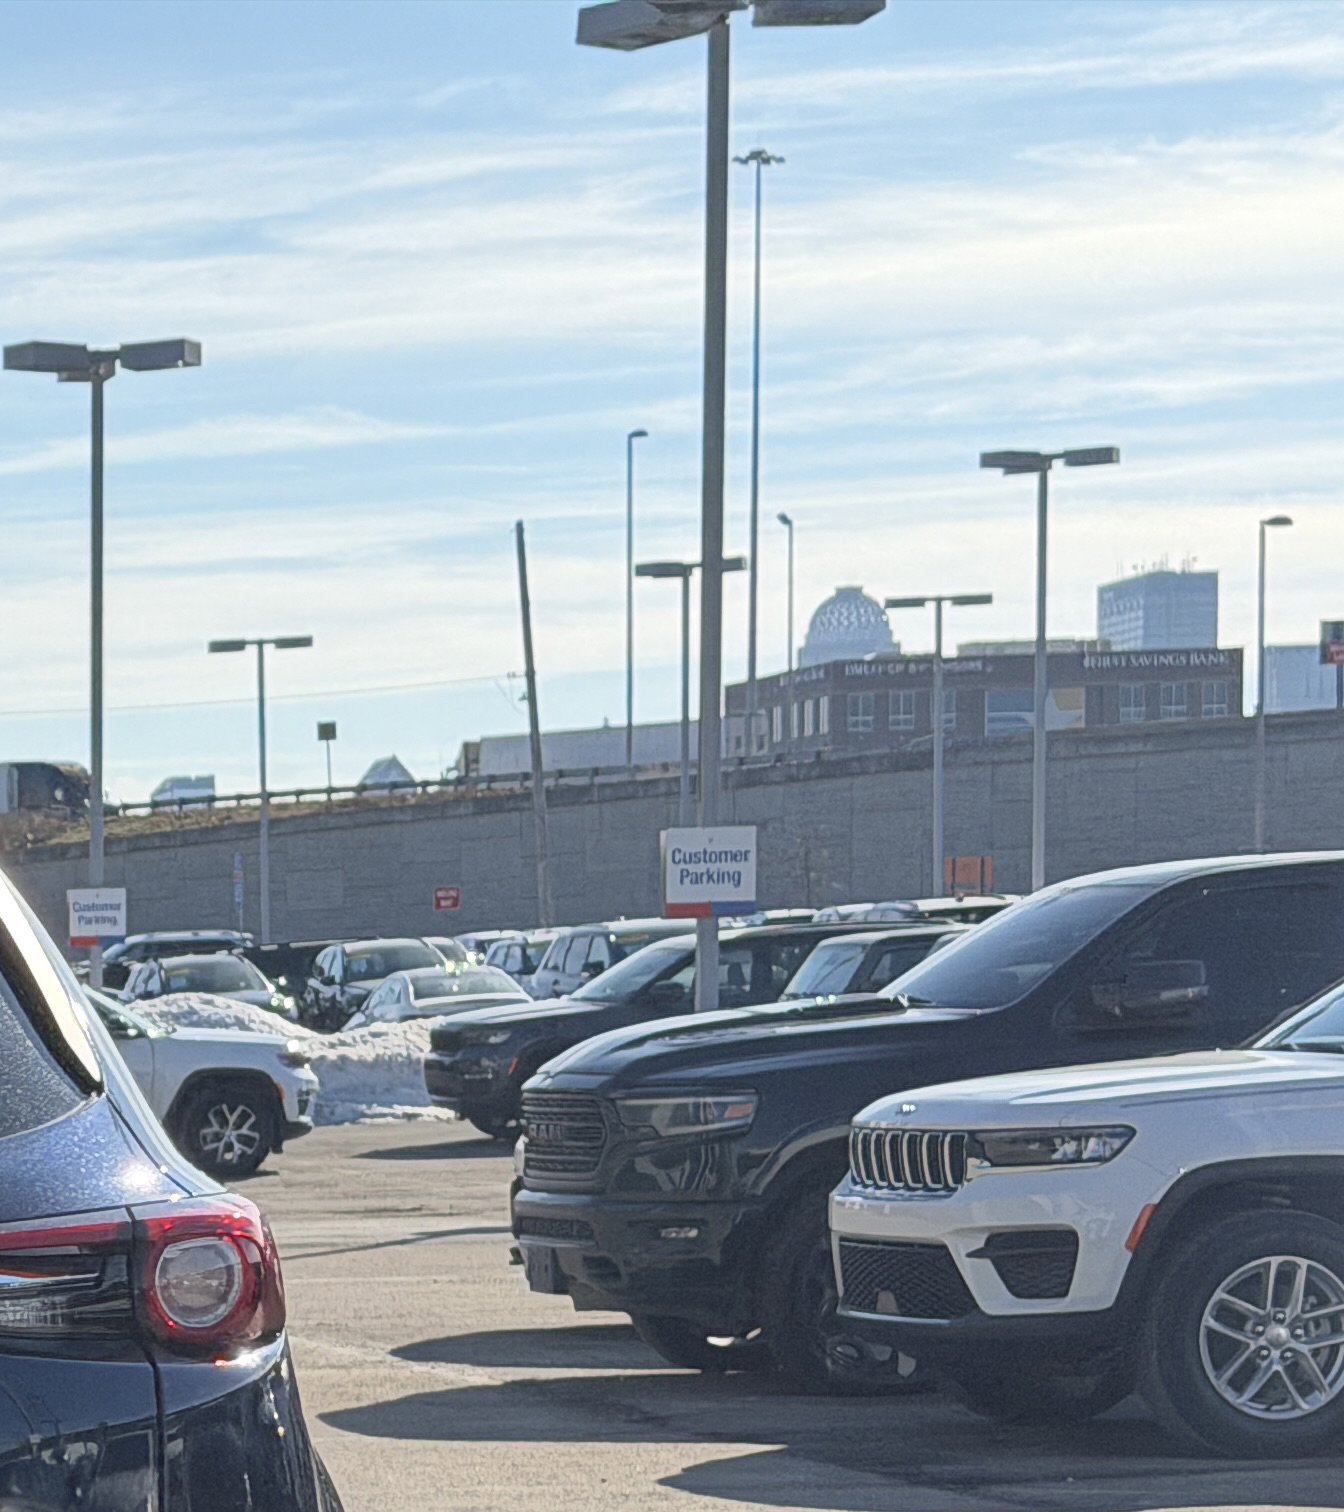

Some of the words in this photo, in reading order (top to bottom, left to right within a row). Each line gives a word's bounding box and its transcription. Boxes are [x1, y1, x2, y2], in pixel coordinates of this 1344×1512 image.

[671, 847, 751, 865] Customer
[679, 867, 742, 888] Parking
[529, 1124, 561, 1140] RAM
